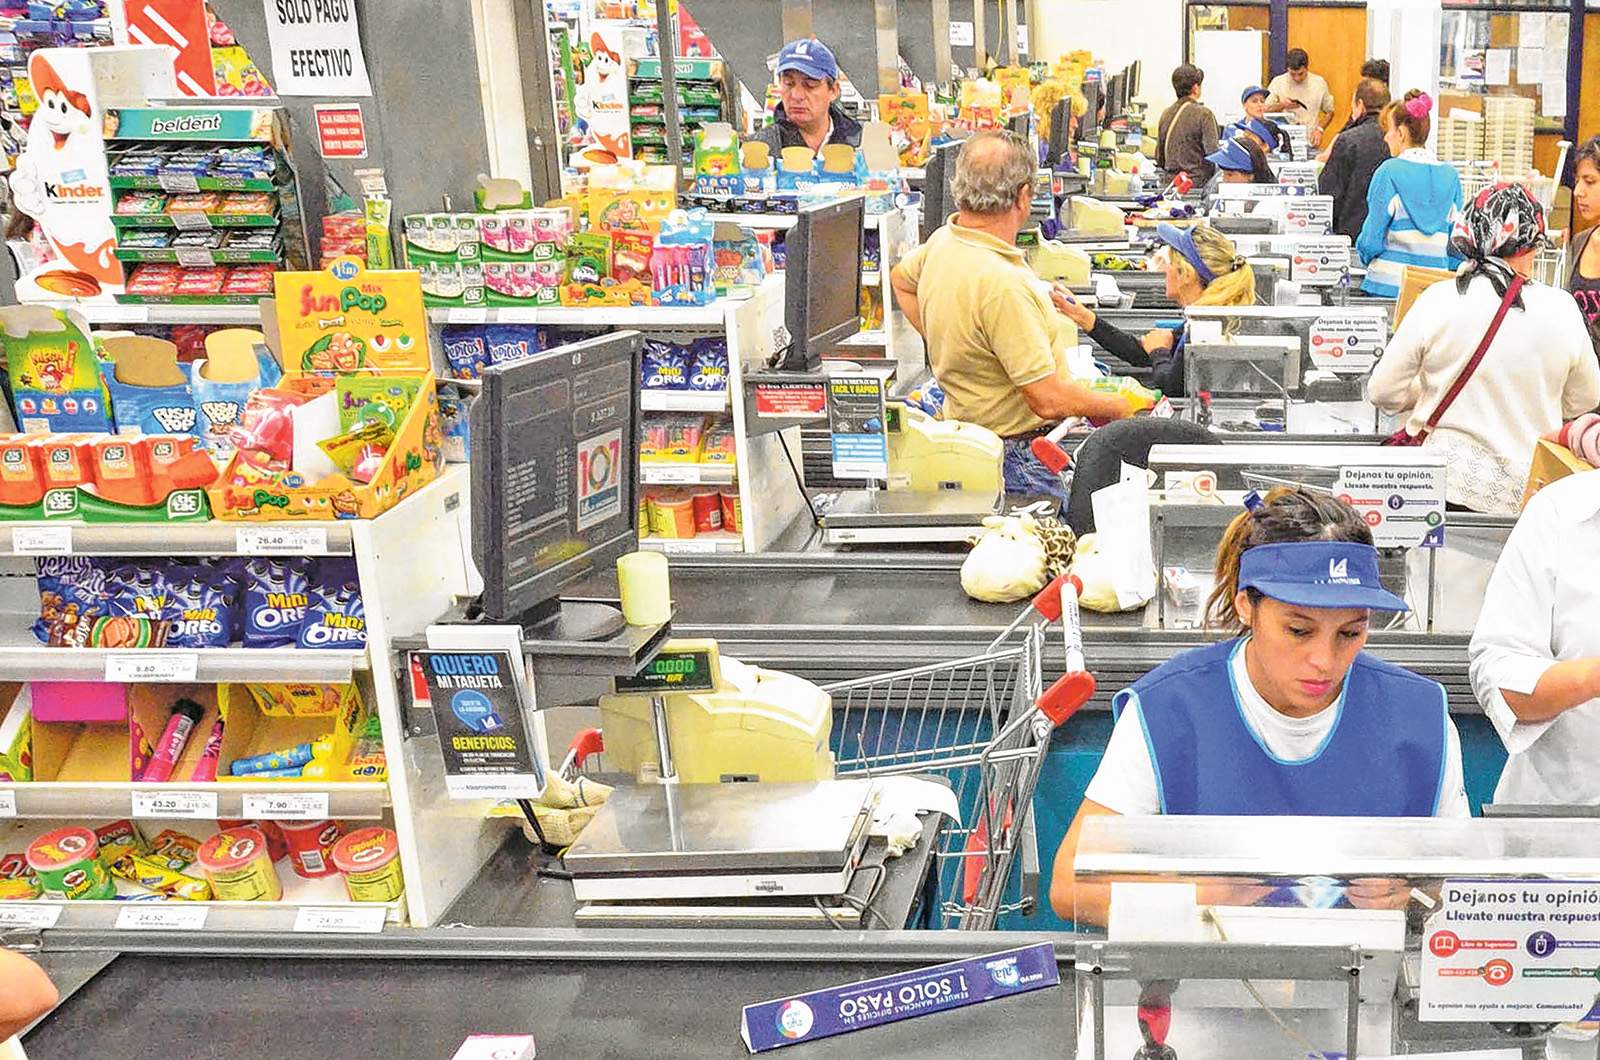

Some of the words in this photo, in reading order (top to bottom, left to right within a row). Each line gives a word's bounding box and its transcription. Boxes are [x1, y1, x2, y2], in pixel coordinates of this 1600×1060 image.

[277, 0, 311, 24] SOLO
[316, 0, 349, 23] PAGO
[290, 48, 353, 77] EFECTIVO
[153, 114, 221, 134] beldent
[44, 181, 104, 197] Kinder
[299, 284, 340, 316] fun
[340, 287, 386, 315] Pop
[579, 438, 620, 497] 101
[1345, 471, 1381, 480] Dejanos
[54, 491, 72, 501] tic
[178, 491, 196, 501] tic
[50, 499, 73, 510] tac
[173, 500, 197, 511] tac
[267, 593, 308, 609] Mini
[184, 609, 217, 621] Mini
[256, 608, 306, 628] ORE
[324, 613, 365, 630] Mini
[170, 620, 222, 637] OREO
[306, 624, 368, 644] OREO
[429, 654, 500, 676] QUIERO
[436, 675, 453, 688] MI
[453, 675, 503, 688] TARJETA
[452, 736, 517, 751] BENEFICIOS:
[353, 766, 384, 776] doll
[1449, 889, 1516, 906] Dejanos
[1523, 890, 1540, 904] tu
[1545, 889, 1600, 908] opinió
[1446, 911, 1494, 922] Llevate
[1497, 912, 1545, 922] nuestra
[1549, 912, 1600, 924] respuest
[995, 968, 1012, 981] ala
[899, 978, 952, 1004] SOLO
